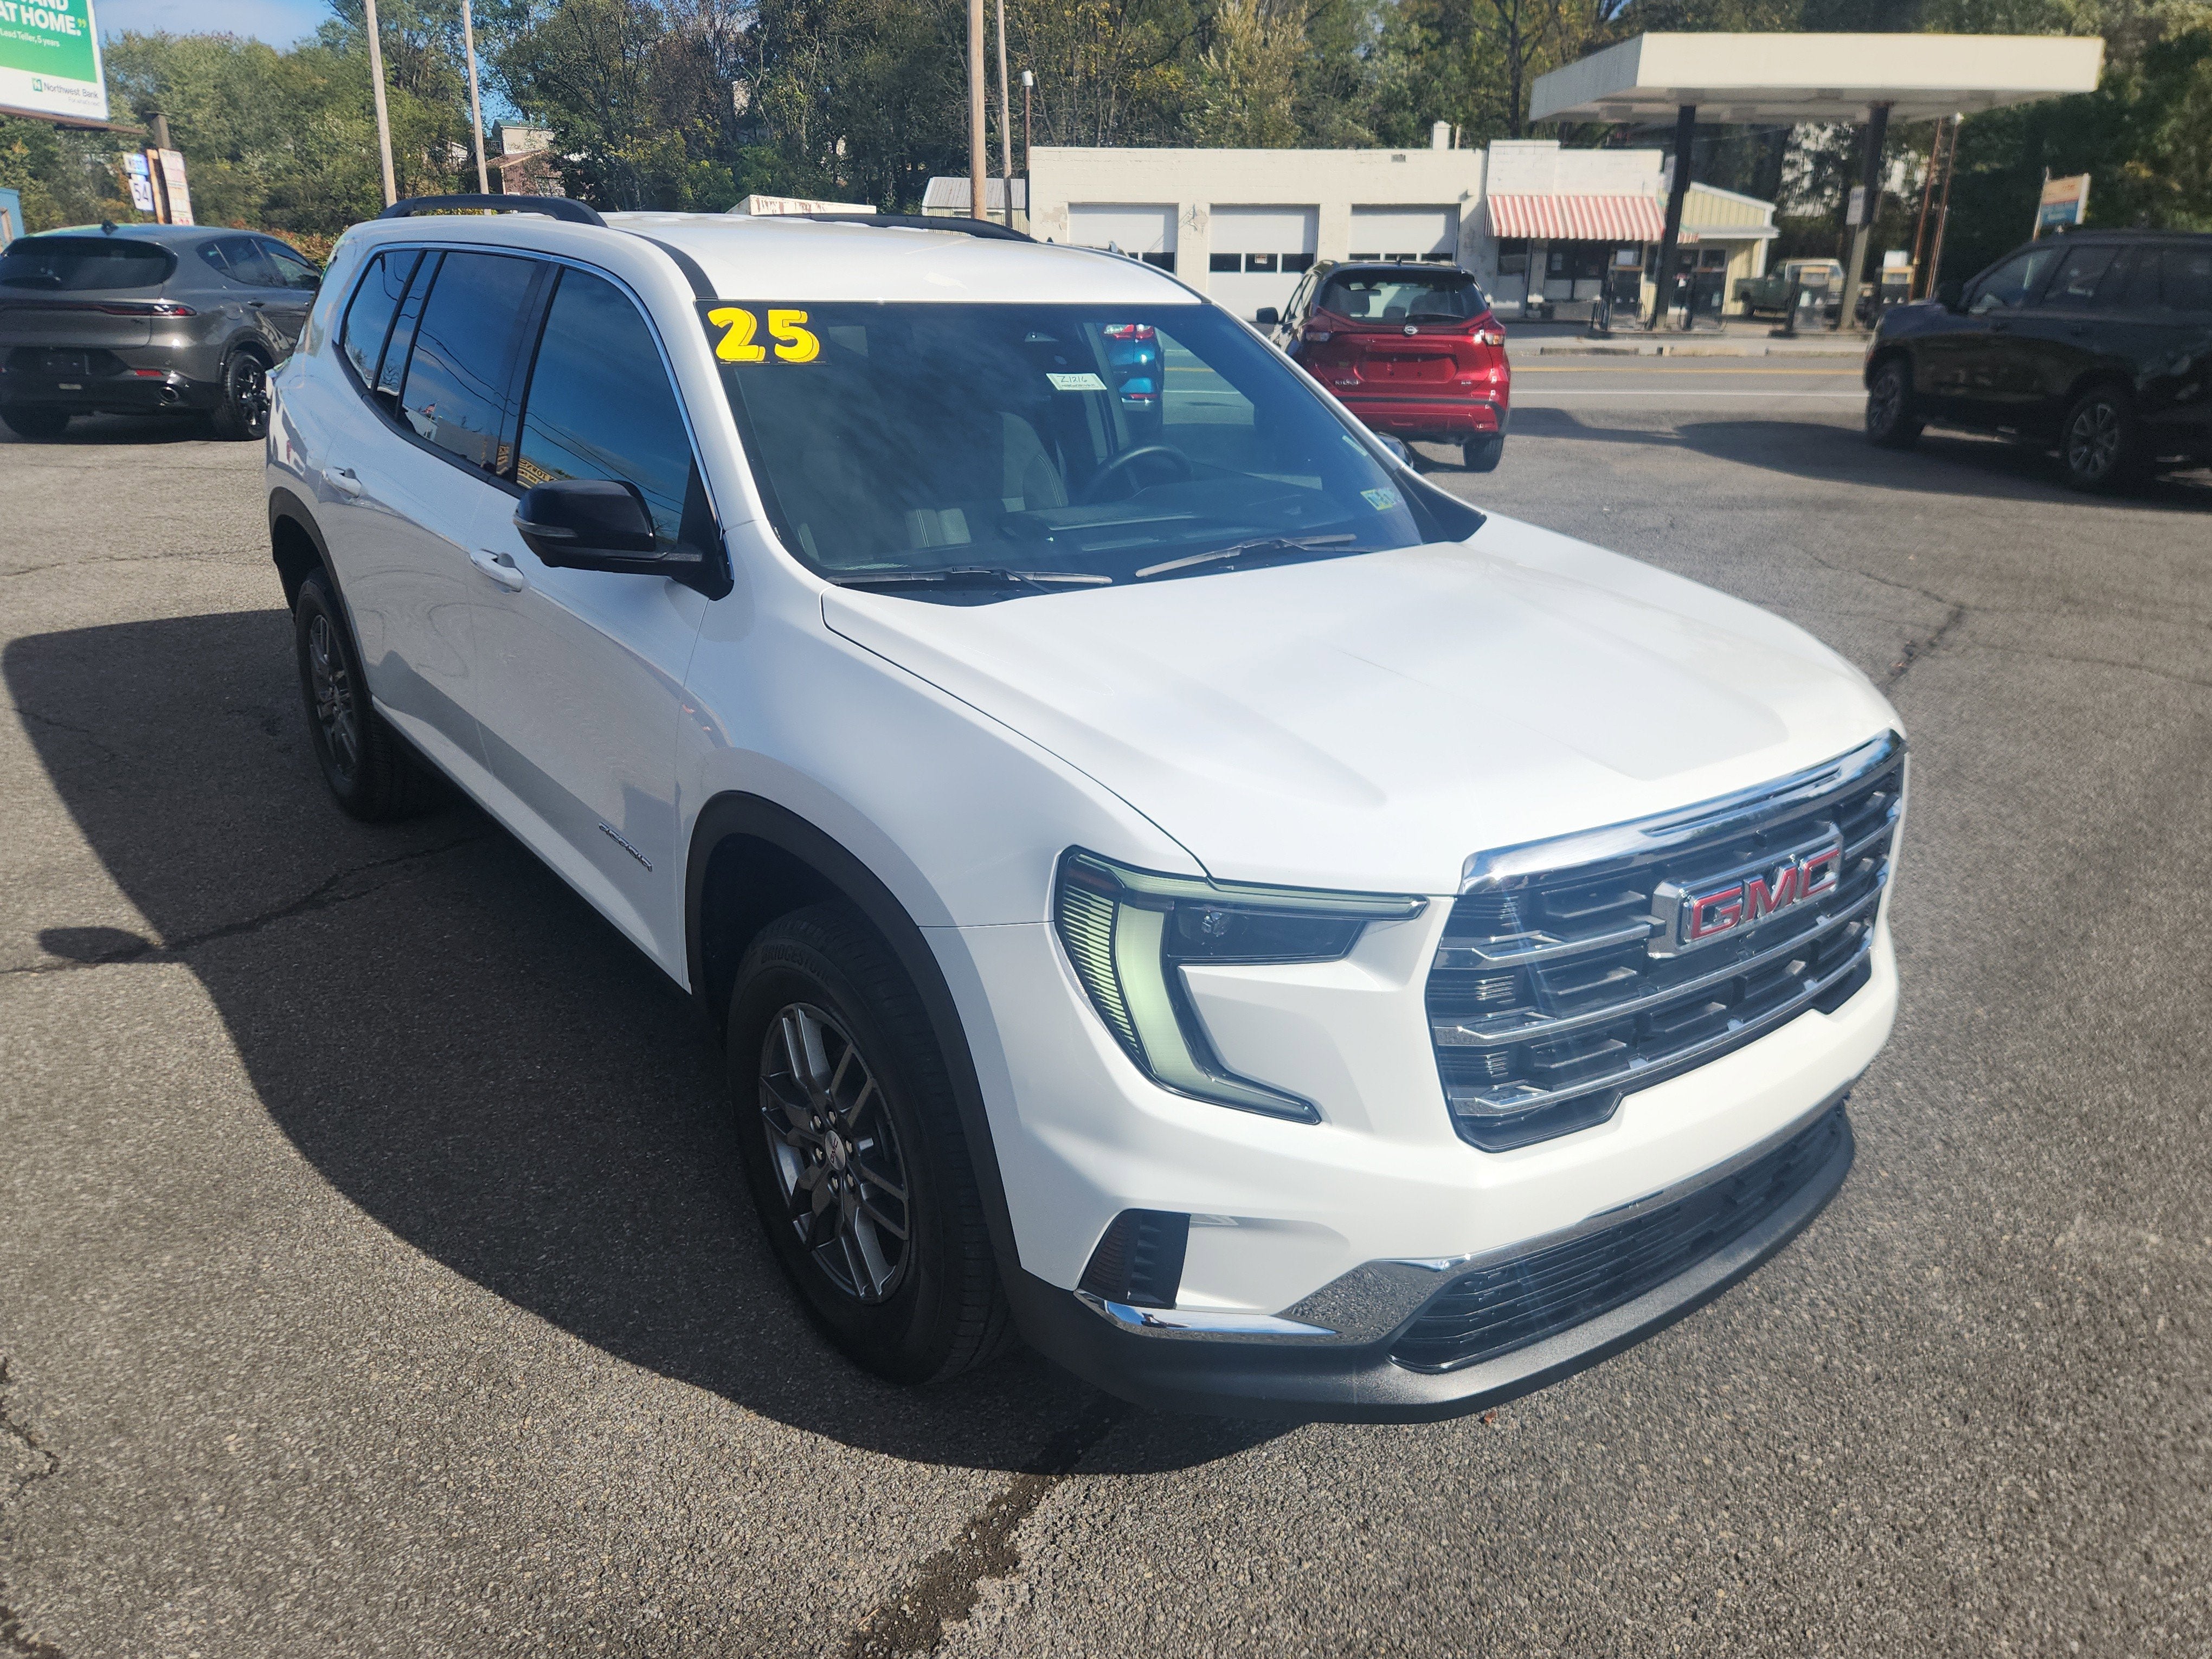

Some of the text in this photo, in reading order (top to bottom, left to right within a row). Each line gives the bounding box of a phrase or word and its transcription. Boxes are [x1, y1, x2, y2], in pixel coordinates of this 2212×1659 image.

[43, 82, 99, 99] Northwest Bank
[708, 307, 820, 363] 25
[1687, 846, 1840, 942] GMC
